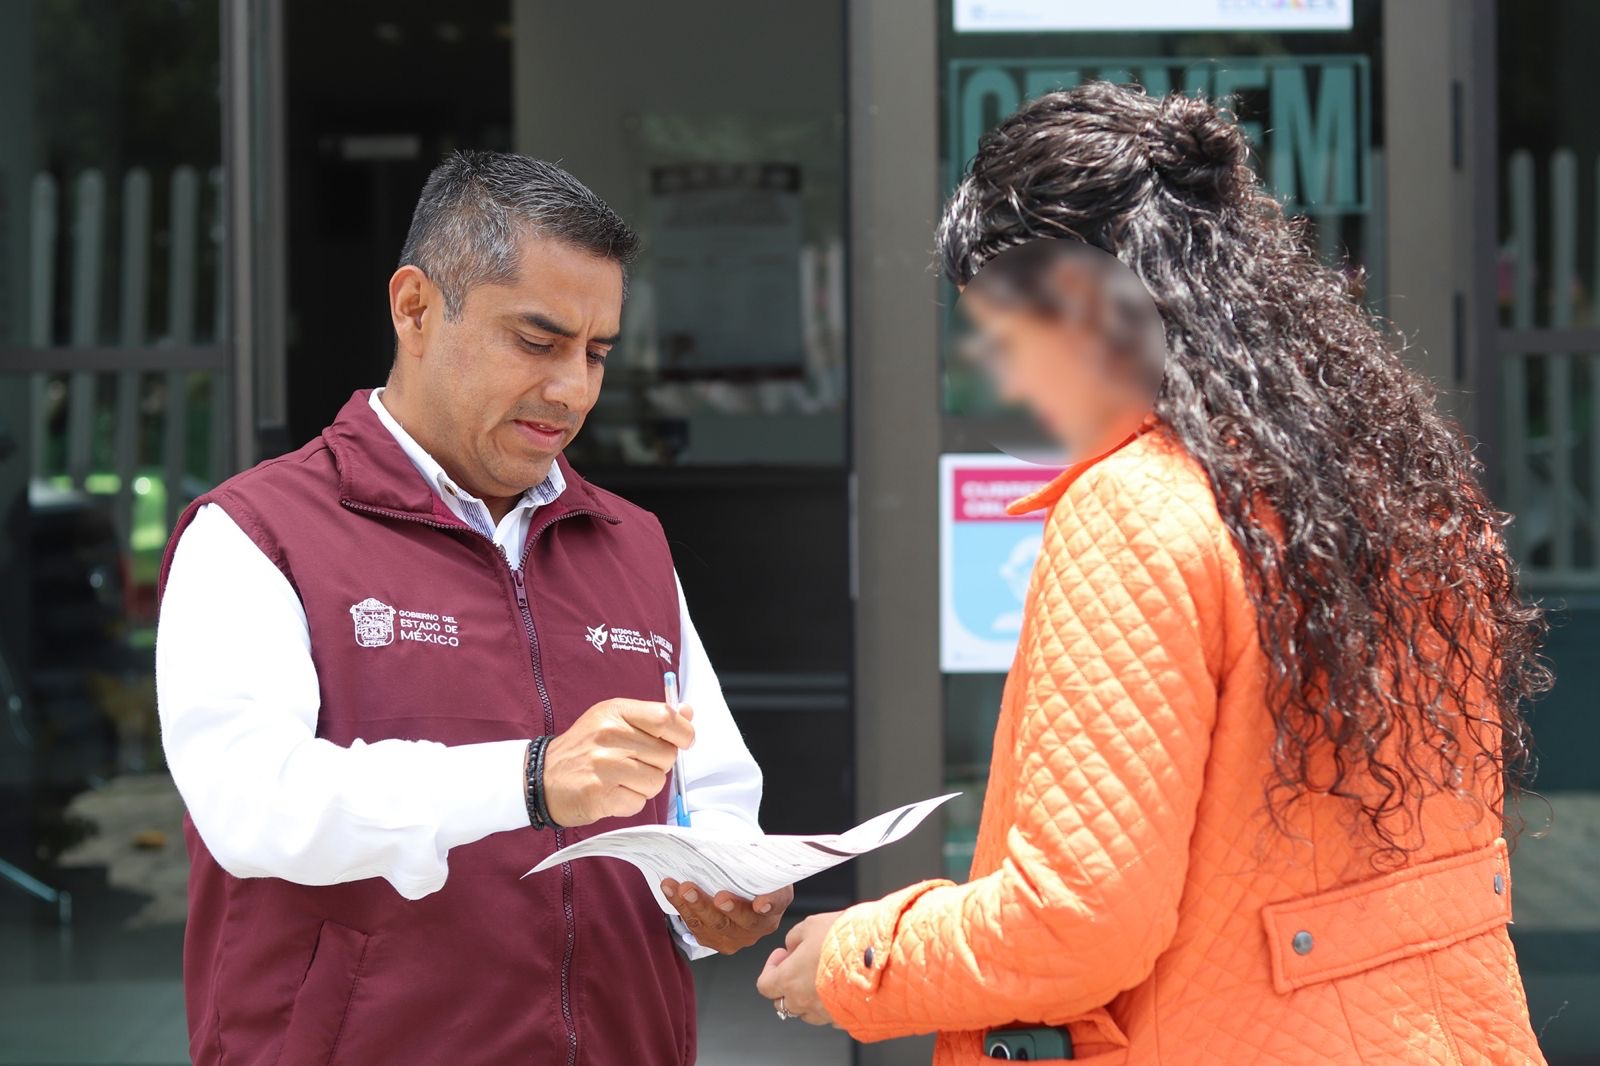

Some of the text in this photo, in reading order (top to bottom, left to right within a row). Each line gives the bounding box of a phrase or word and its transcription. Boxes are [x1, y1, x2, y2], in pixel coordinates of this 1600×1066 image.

[399, 610, 439, 621] GOBIERNO
[400, 618, 459, 634] ESTADO DE
[400, 628, 459, 646] MÉXICO
